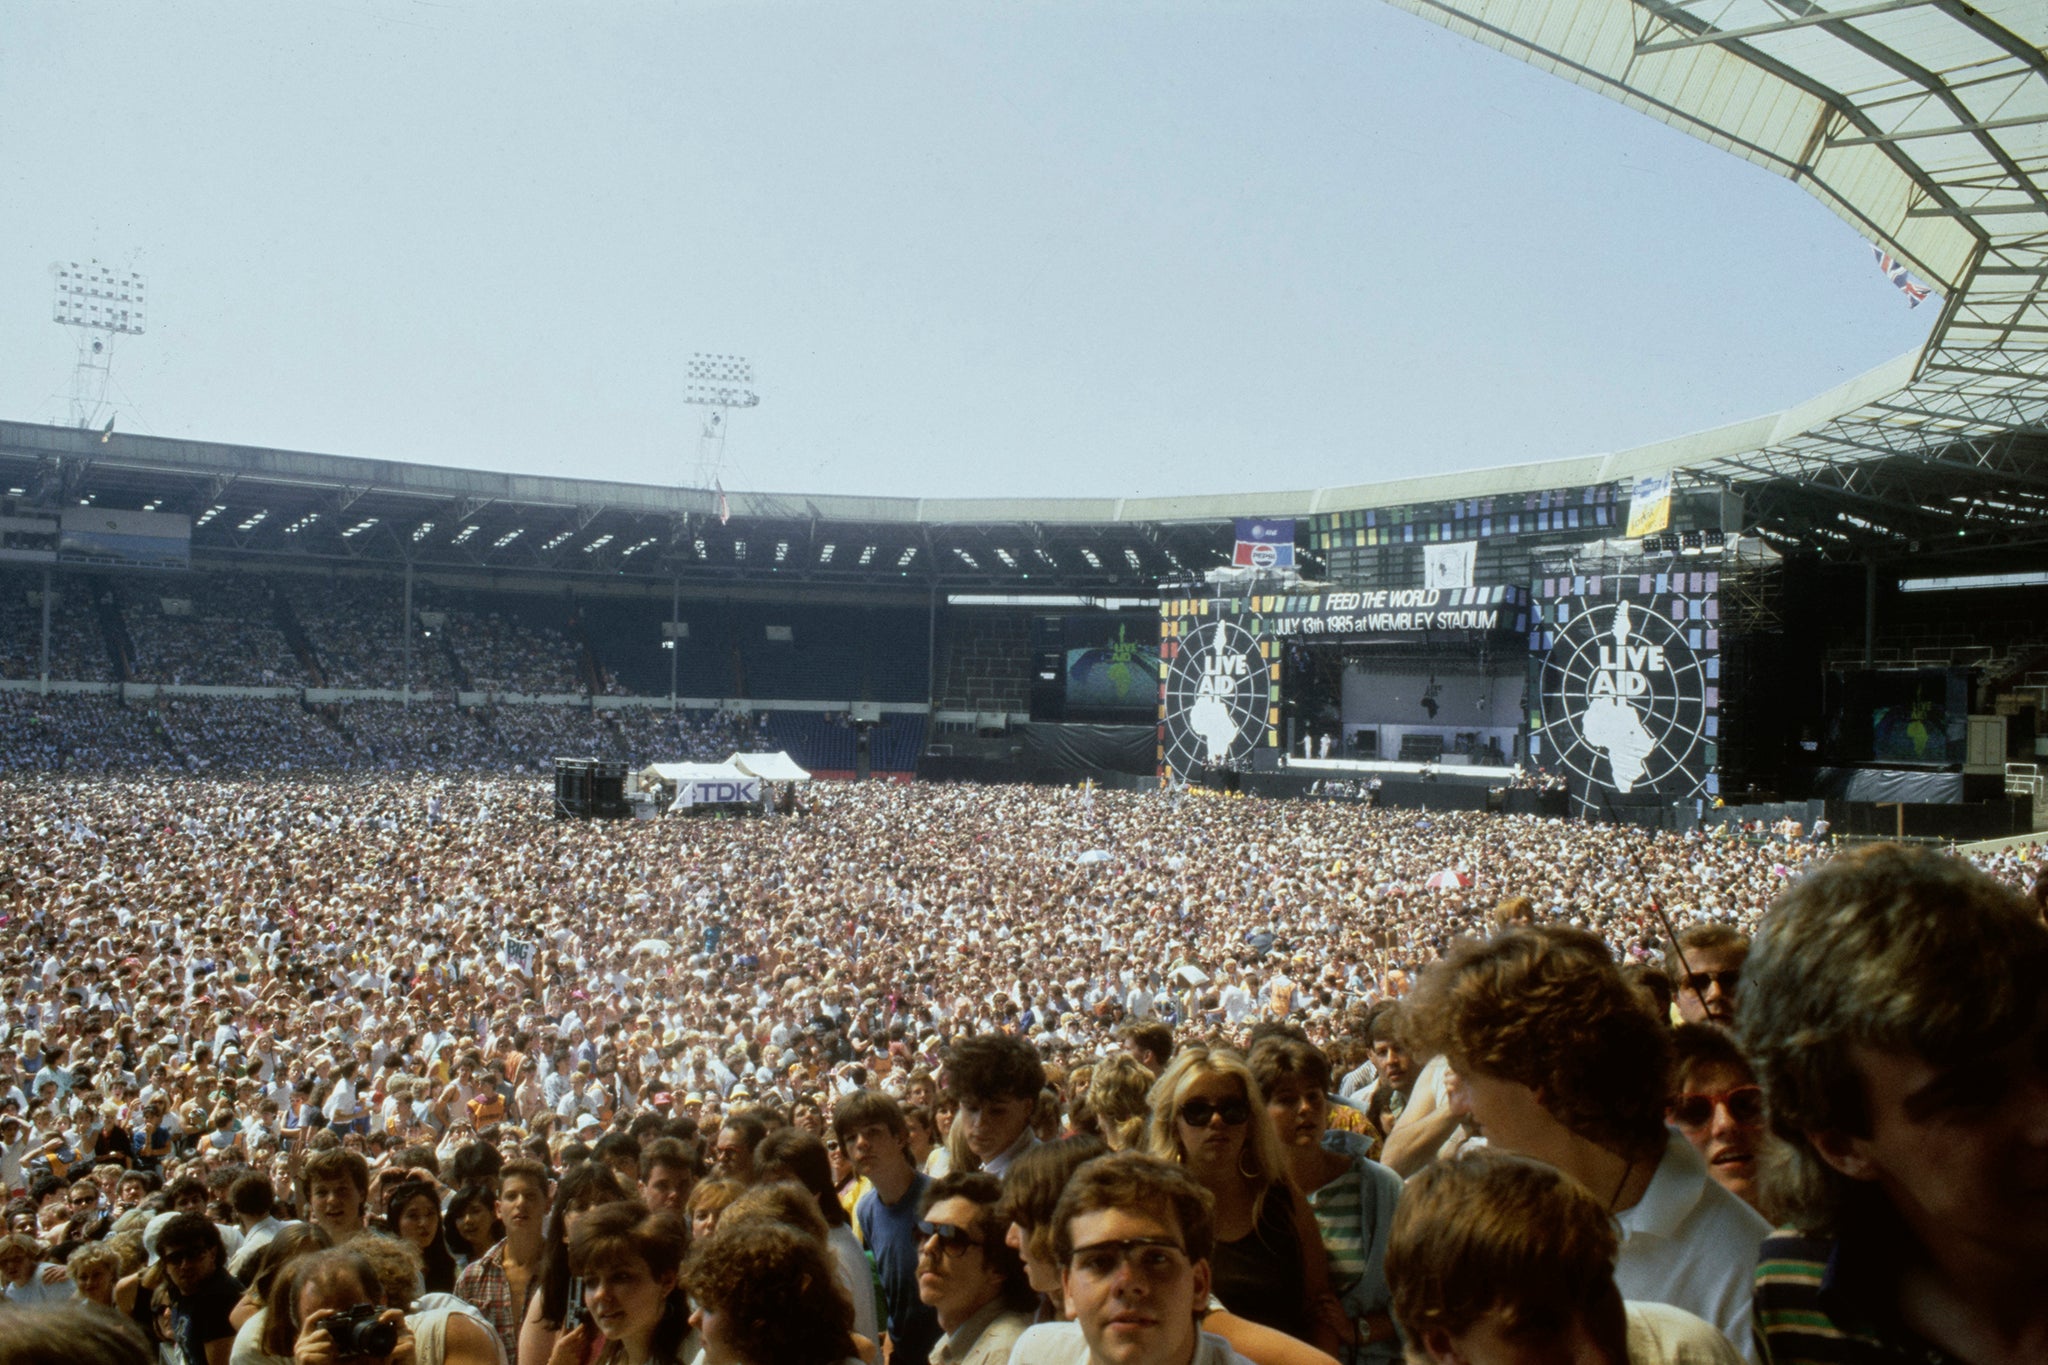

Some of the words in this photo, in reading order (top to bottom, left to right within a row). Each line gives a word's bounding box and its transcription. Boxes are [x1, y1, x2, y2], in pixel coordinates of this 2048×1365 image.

[1325, 592, 1360, 611] FEED
[1362, 590, 1388, 609] THE
[1389, 588, 1440, 608] WORLD
[1276, 617, 1300, 635] JULY
[1302, 616, 1324, 634] 13th
[1326, 615, 1353, 633] 1985
[1354, 617, 1367, 632] at
[1368, 611, 1435, 631] WEMBLEY
[1436, 609, 1498, 630] STADIUM
[1205, 654, 1247, 675] LIVE
[1599, 645, 1664, 671] LIVE
[1199, 674, 1235, 695] AID
[1591, 670, 1646, 696] AID
[697, 782, 755, 801] TDK
[507, 938, 529, 959] BIG
